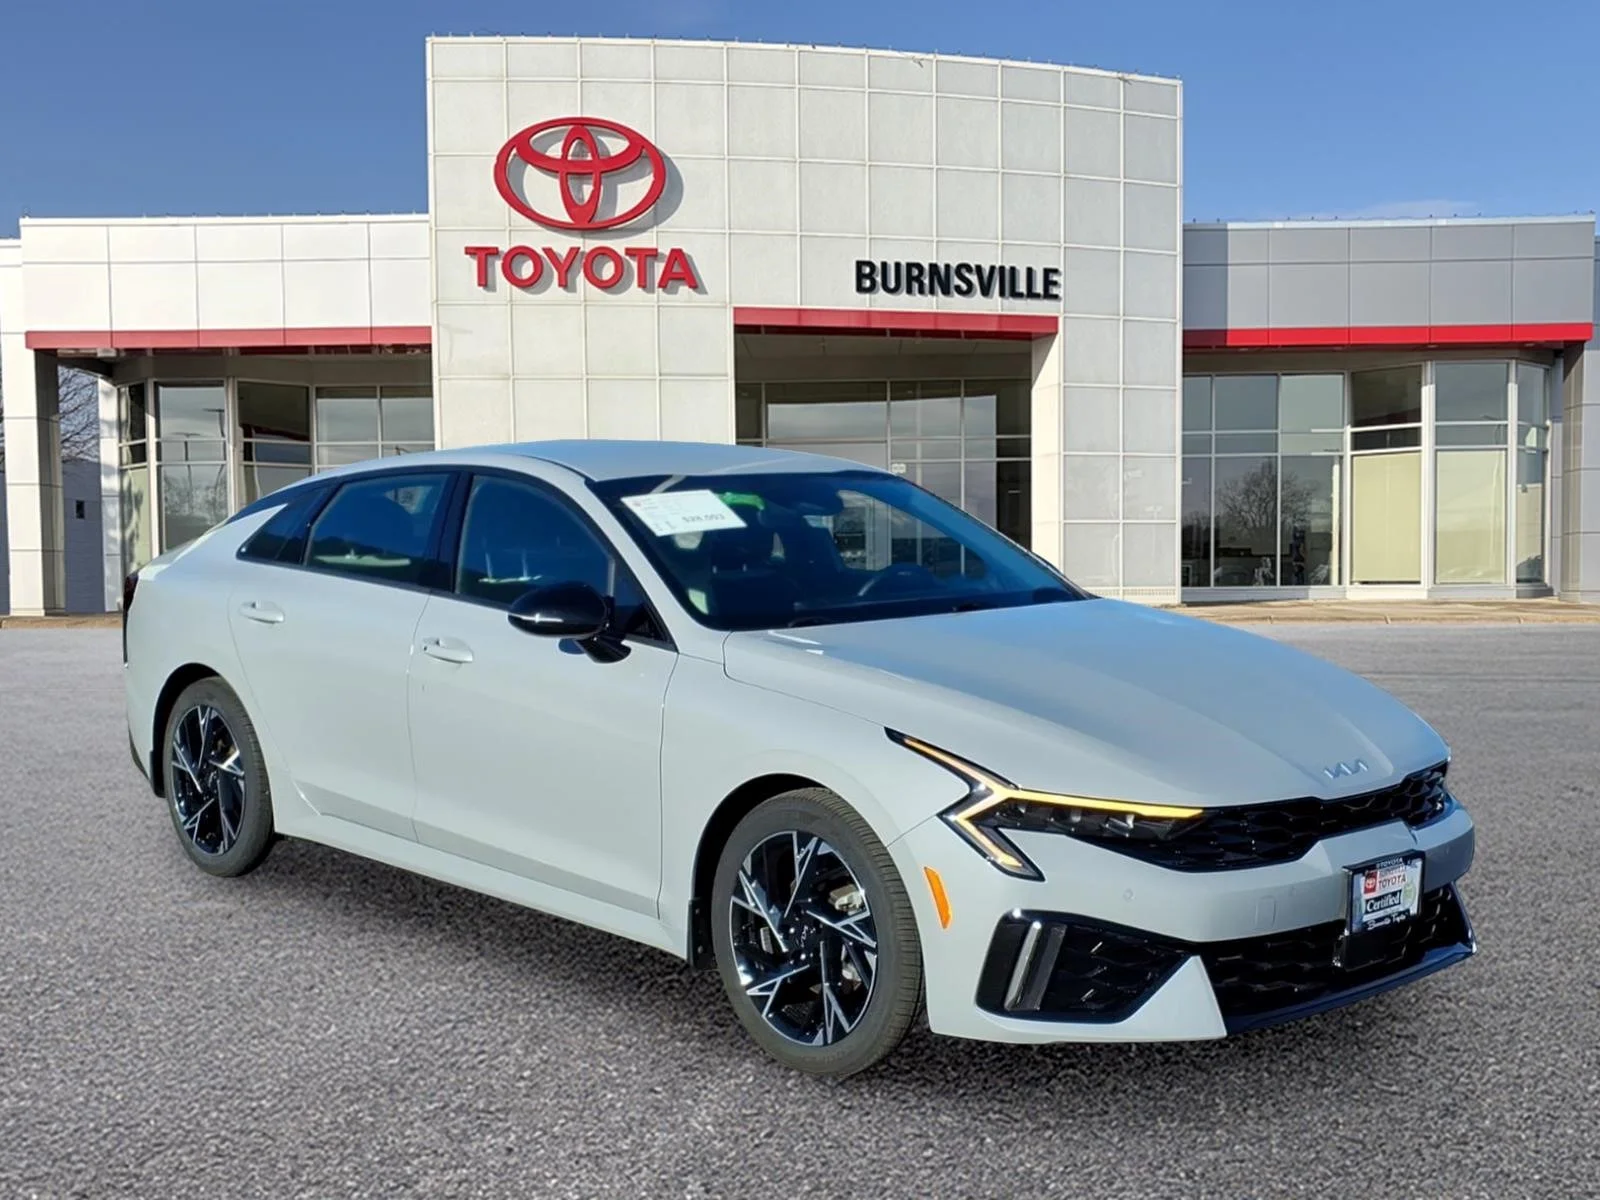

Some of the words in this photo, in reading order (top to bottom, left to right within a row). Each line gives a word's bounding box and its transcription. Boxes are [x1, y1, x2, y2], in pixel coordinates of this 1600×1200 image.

[464, 245, 698, 289] TOYOTA
[855, 260, 1061, 300] BURNSVILLE
[1379, 873, 1406, 889] TOYOTA
[1367, 891, 1400, 912] Certified
